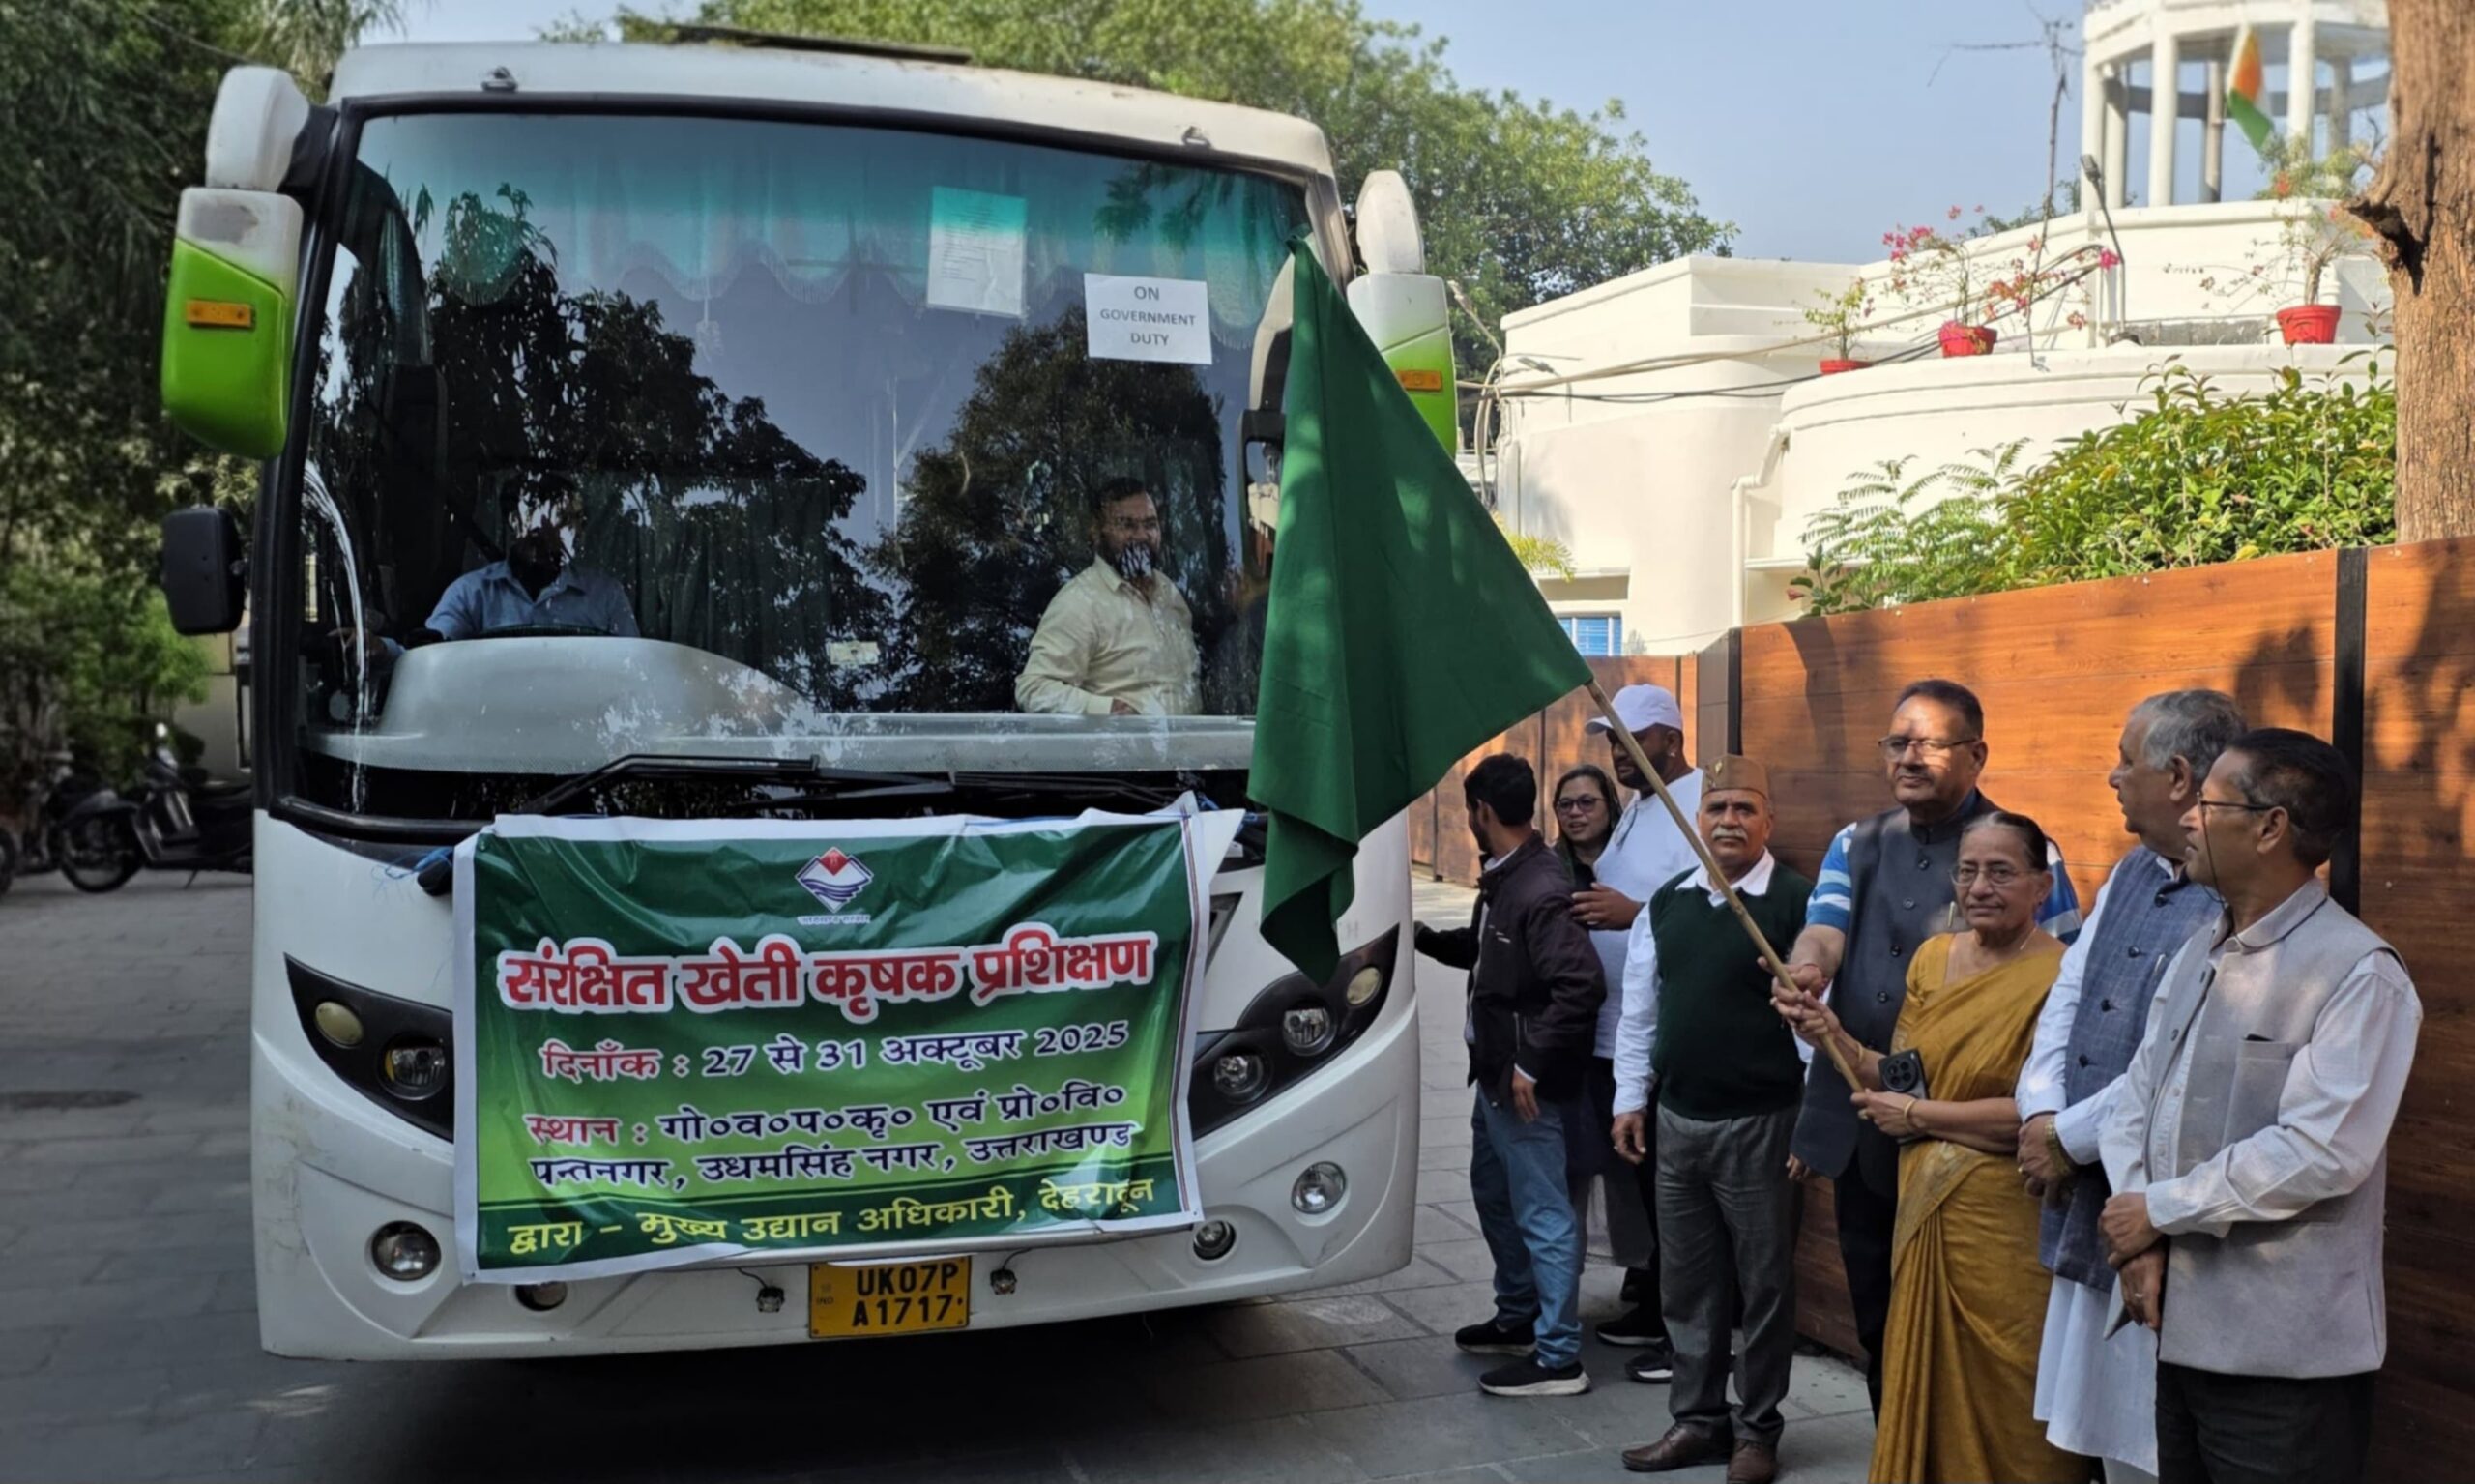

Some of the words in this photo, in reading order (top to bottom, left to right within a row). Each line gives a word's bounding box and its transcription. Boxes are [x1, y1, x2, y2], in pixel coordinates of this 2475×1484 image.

[1133, 285, 1160, 302] ON
[1099, 308, 1196, 326] GOVERNMENT
[1130, 332, 1170, 347] DUTY
[504, 944, 669, 1007] संरक्षित
[681, 941, 801, 1006] खेती
[813, 953, 960, 1016] कृषक
[972, 928, 1151, 1000] प्रशिक्षण
[705, 1048, 754, 1076] 27
[765, 1036, 803, 1071] से
[819, 1042, 864, 1068] 31
[883, 1032, 1024, 1070] अक्टूबर
[1036, 1022, 1127, 1054] 2025
[525, 1116, 620, 1143] स्थान
[927, 1091, 987, 1133] एवं
[696, 1143, 856, 1180] उधमसिंह
[965, 1122, 1135, 1161] उत्तराखण्ड
[508, 1220, 583, 1254] द्वारा
[635, 1211, 728, 1244] मुख्य
[740, 1210, 842, 1240] उद्यान
[1038, 1178, 1154, 1213] देहरादून
[856, 1262, 959, 1296] UK07P
[852, 1294, 953, 1327] A1717
